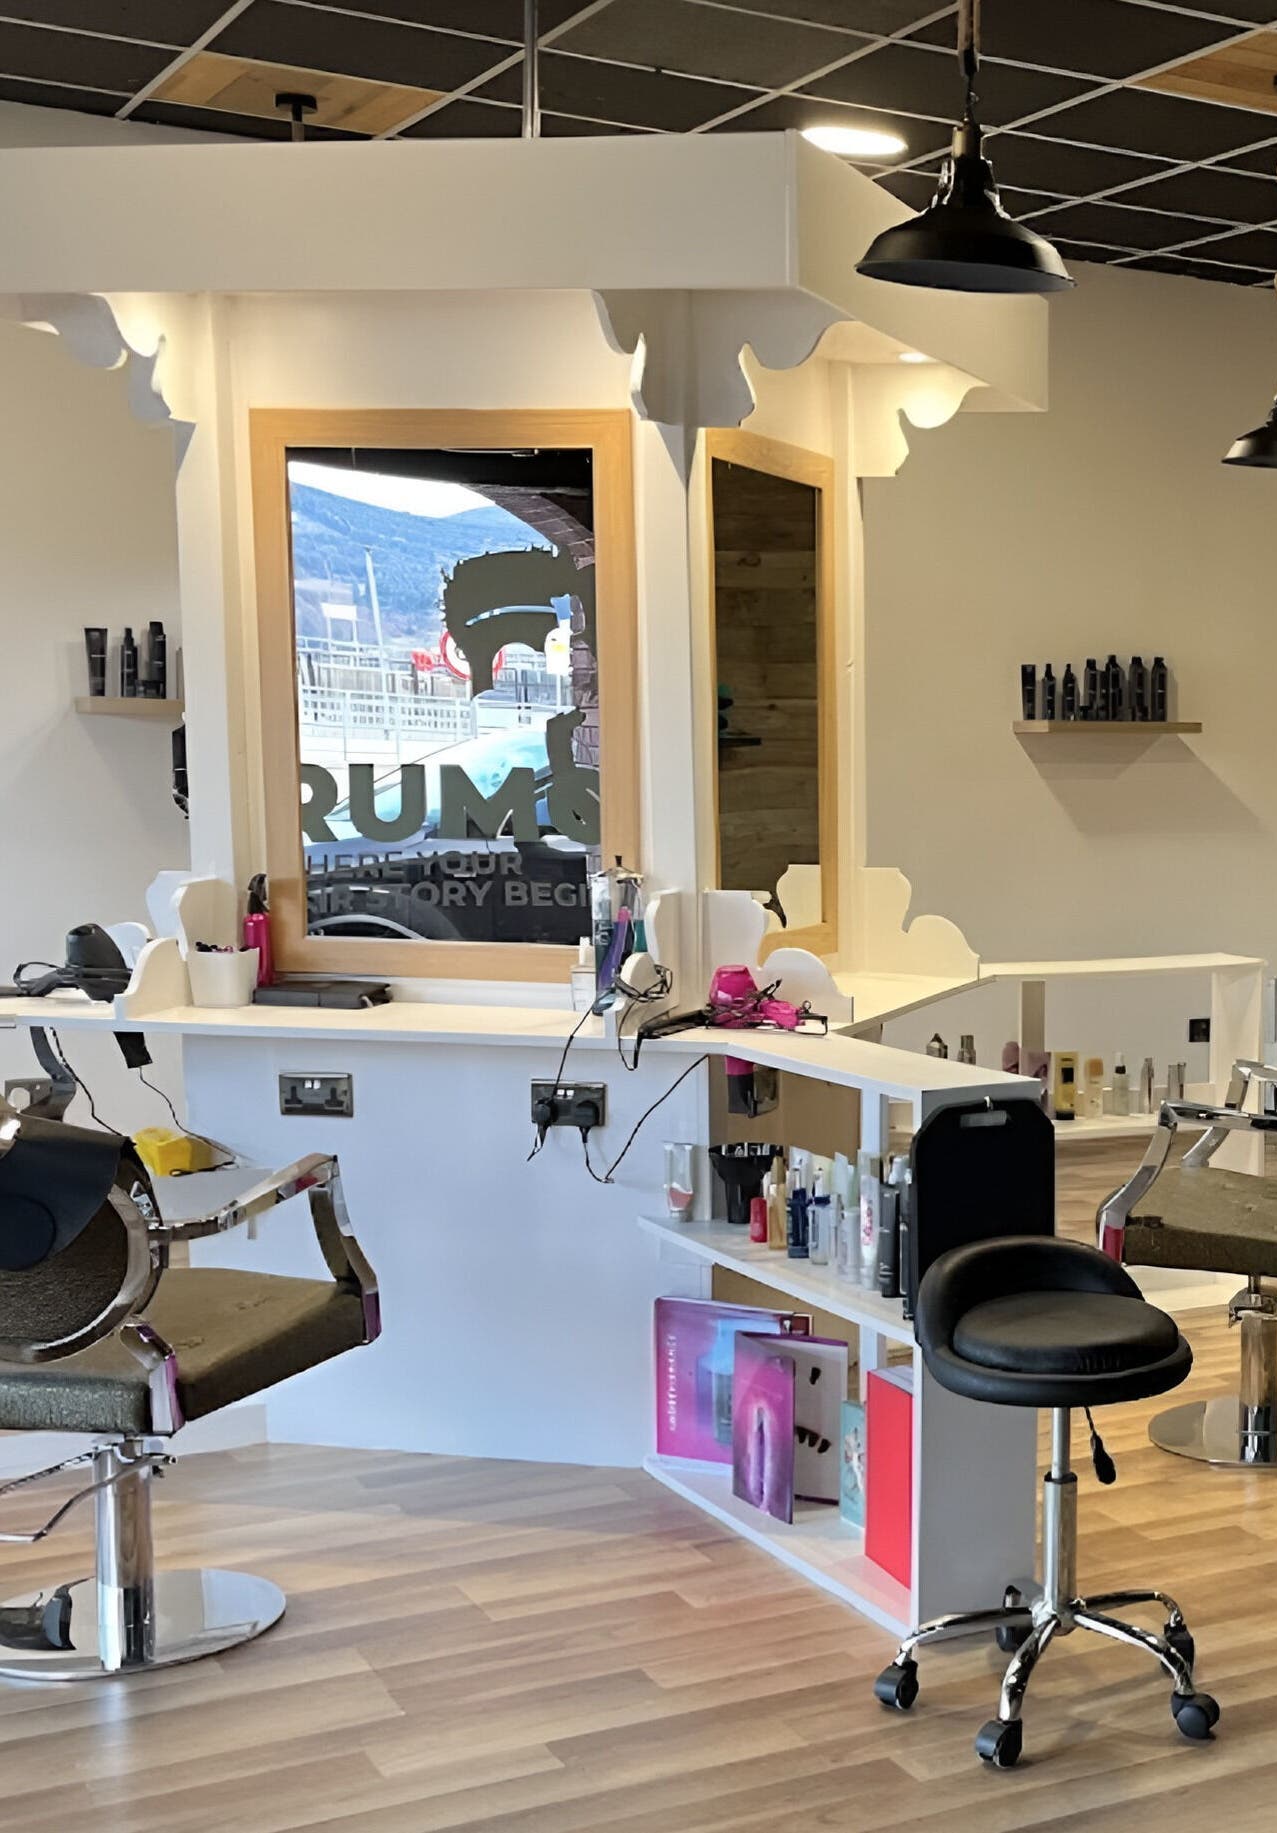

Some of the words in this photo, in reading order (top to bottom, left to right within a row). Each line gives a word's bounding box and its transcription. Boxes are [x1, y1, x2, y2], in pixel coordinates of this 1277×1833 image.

[417, 850, 523, 877] YOUR
[365, 881, 493, 910] STORY
[504, 881, 591, 907] BEGI
